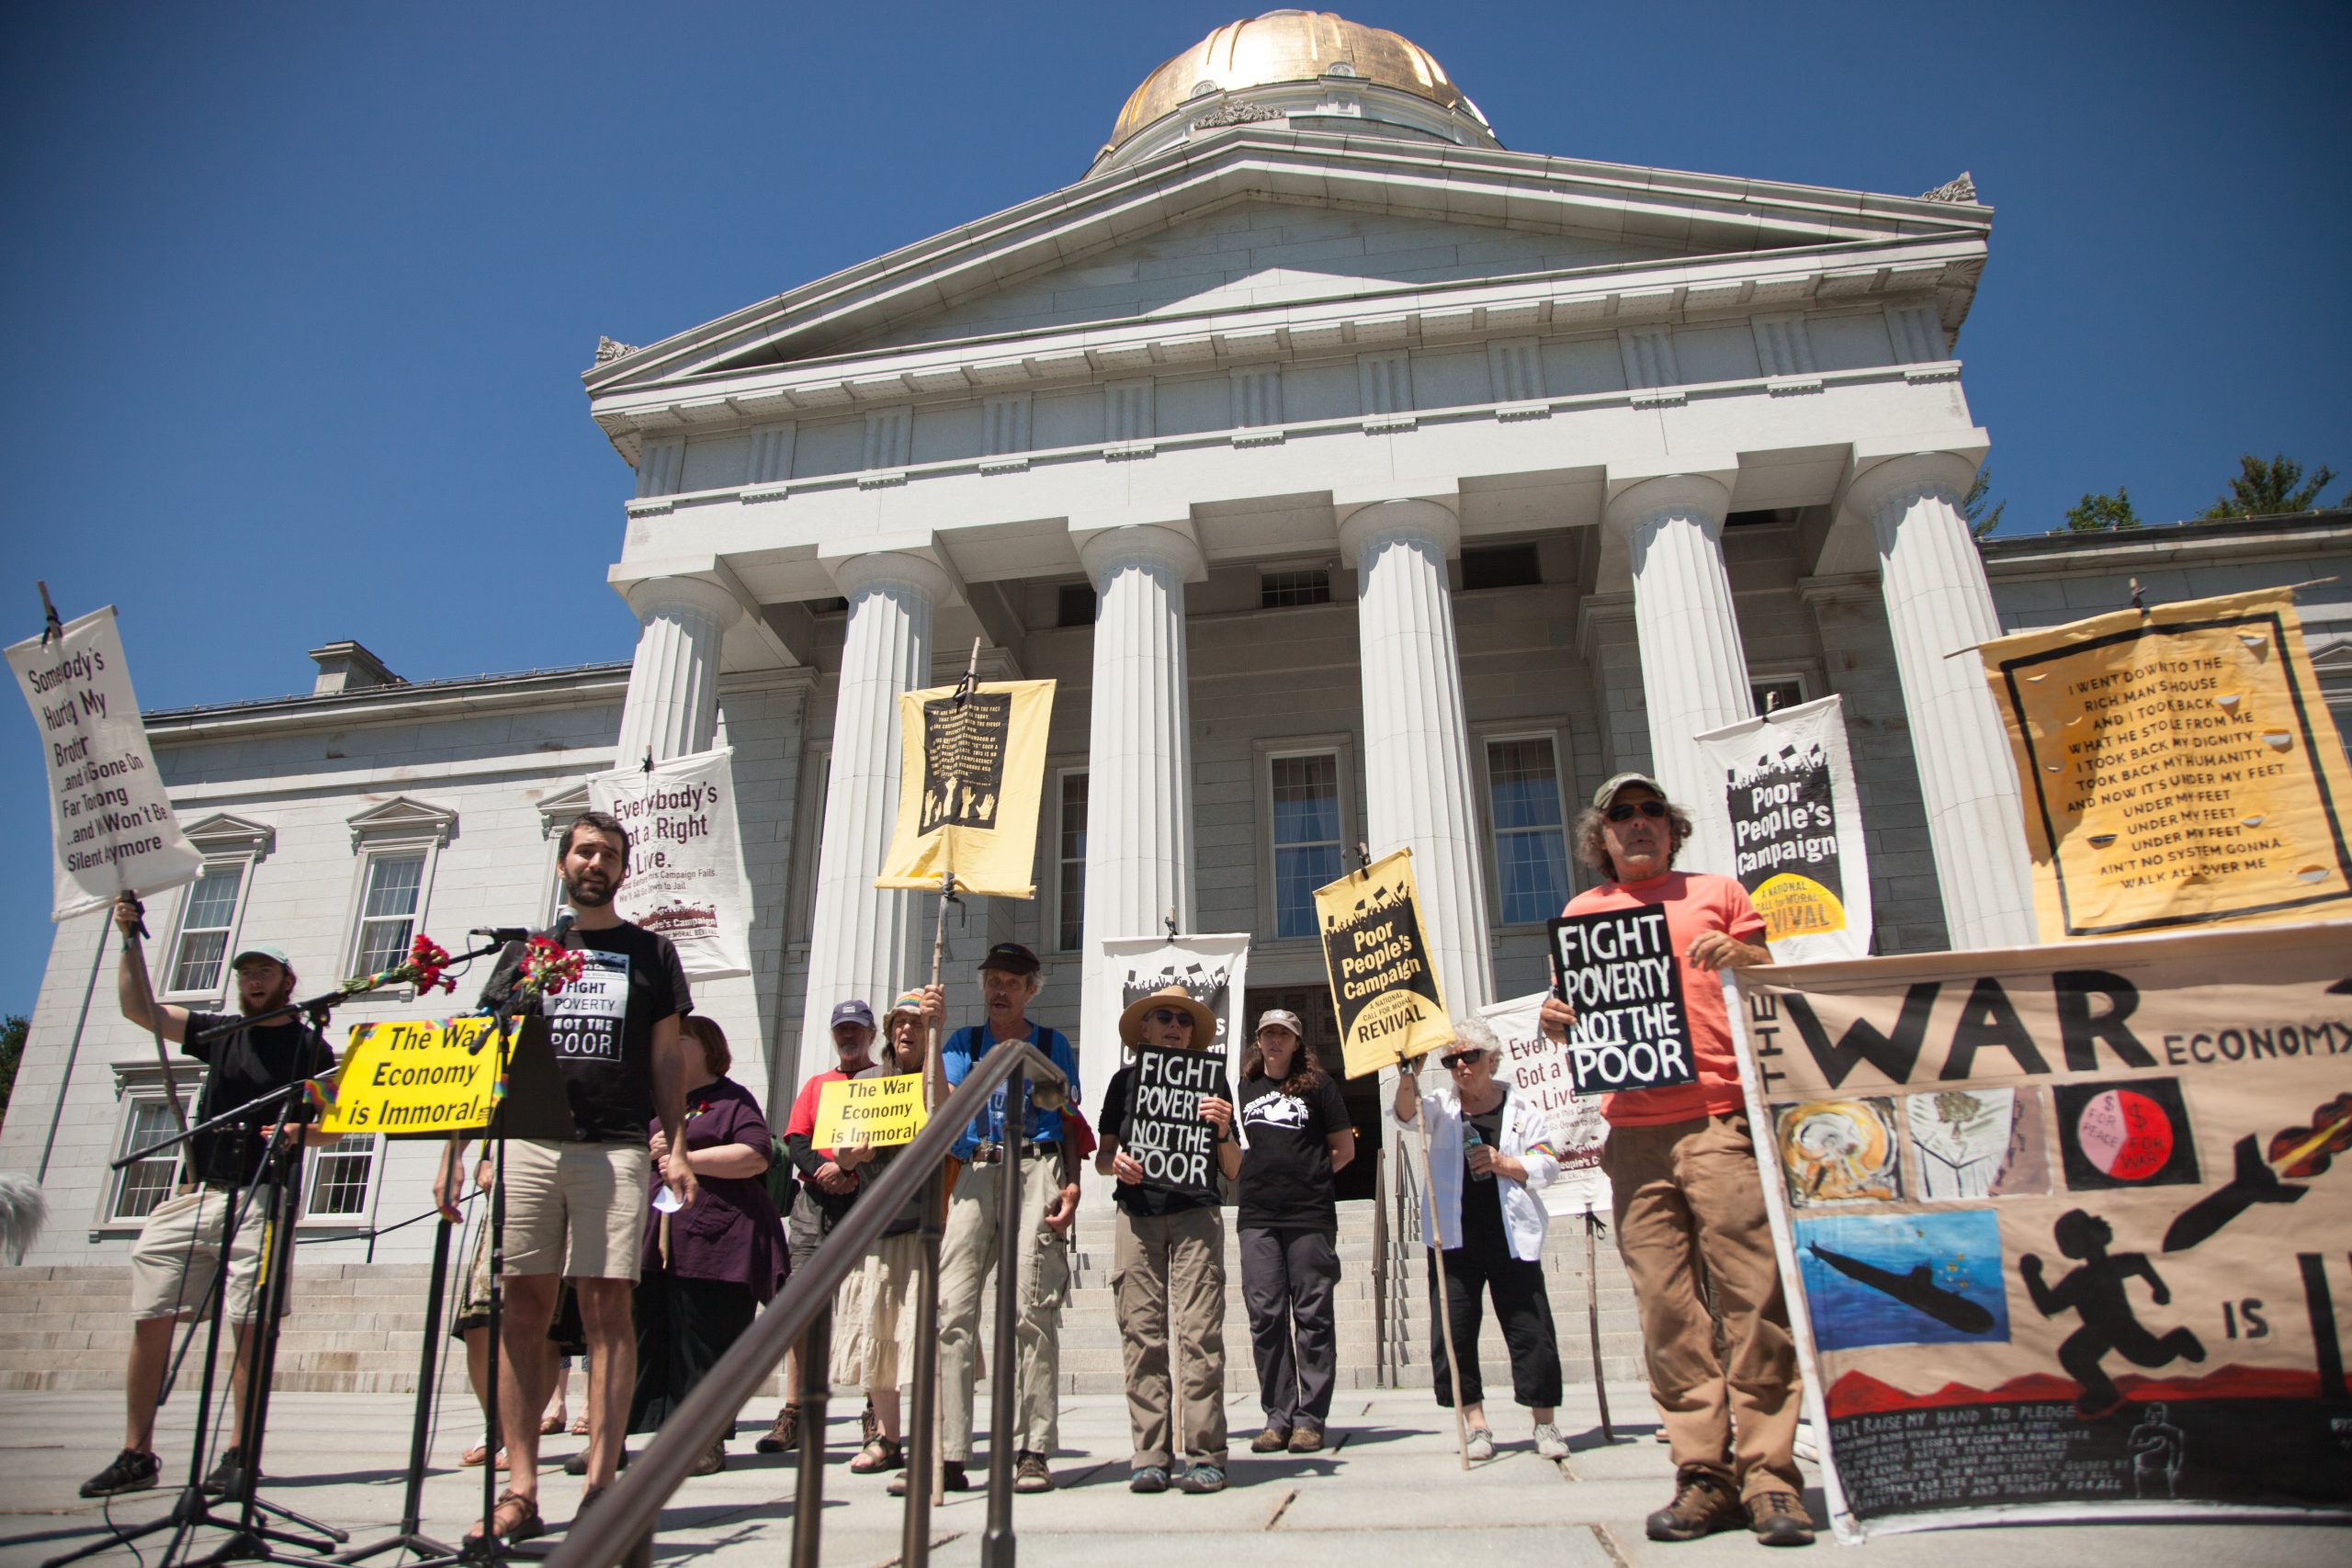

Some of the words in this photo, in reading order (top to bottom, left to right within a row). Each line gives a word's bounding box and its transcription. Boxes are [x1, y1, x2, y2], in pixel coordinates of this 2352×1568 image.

[2067, 684, 2075, 696] I
[2076, 672, 2120, 694] WENT
[2122, 660, 2169, 684] DOWN
[2168, 660, 2188, 674] TO
[2192, 656, 2224, 671] THE
[79, 688, 107, 719] My
[2084, 695, 2120, 713] RICH
[2123, 679, 2168, 705] MAN'S
[2168, 676, 2219, 694] HOUSE
[2093, 714, 2124, 731] AND
[2128, 710, 2134, 723] I
[2137, 699, 2177, 720] TOOK
[2177, 697, 2216, 712] BACK
[2068, 736, 2113, 755] WHAT
[2117, 730, 2138, 745] HE
[2142, 717, 2182, 739] STOLE
[2185, 715, 2227, 730] FROM
[2231, 711, 2255, 726] ME
[86, 759, 128, 781] Gone
[125, 752, 145, 772] On
[2075, 761, 2083, 773] I
[2085, 752, 2127, 773] TOOK
[2130, 739, 2169, 761] BACK
[2172, 736, 2189, 749] MY
[2192, 730, 2255, 749] DIGNITY
[2075, 773, 2119, 792] TOOK
[2121, 762, 2161, 782] BACK
[2164, 755, 2184, 771] MY
[2186, 750, 2264, 768] HUMANITY
[62, 799, 82, 819] Far
[95, 787, 130, 807] ong
[613, 781, 718, 822] Everybody's
[1751, 781, 1802, 815] Poor
[2066, 797, 2097, 813] AND
[2100, 786, 2137, 805] NOW
[2169, 773, 2216, 787] UNDER
[2220, 770, 2242, 784] MY
[2248, 762, 2286, 779] FEET
[102, 806, 153, 833] Won't
[150, 803, 168, 821] Be
[2123, 796, 2174, 818] UNDER
[2176, 790, 2195, 804] MY
[2198, 789, 2232, 802] FEET
[627, 825, 640, 849] ot
[644, 825, 650, 843] a
[656, 814, 708, 845] Right
[1736, 801, 1832, 848] People's
[2127, 814, 2178, 835] UNDER
[2180, 809, 2200, 822] MY
[2203, 807, 2236, 820] FEET
[2132, 830, 2182, 852] UNDER
[2186, 828, 2205, 840] MY
[2208, 825, 2243, 838] FEET
[67, 848, 104, 873] Silent
[637, 851, 672, 876] Live.
[1736, 833, 1838, 876] Campaign
[2100, 859, 2137, 876] AIN'T
[2141, 853, 2165, 868] NO
[2167, 843, 2222, 864] SYSTEM
[2226, 837, 2282, 854] GONNA
[660, 870, 696, 881] Campaign
[2120, 872, 2166, 889] WALK
[2171, 864, 2200, 880] ALL
[2201, 861, 2240, 874] OVER
[2245, 857, 2267, 871] ME
[1761, 887, 1768, 898] A
[1769, 880, 1807, 897] NATIONAL
[1785, 892, 1819, 905] MORAL
[673, 917, 717, 929] Campaign
[1762, 903, 1830, 936] EVIVAL
[1353, 920, 1394, 953] Poor
[1557, 914, 1665, 969] FIGHT
[1341, 934, 1413, 979] People's
[566, 981, 607, 995] FIGHT
[1343, 958, 1422, 1000] Campaign
[1563, 955, 1670, 1008] POVERTY
[554, 998, 616, 1011] POVERTY
[1363, 1010, 1379, 1022] CALL
[1379, 1005, 1391, 1017] FOR
[1391, 996, 1413, 1011] MORAL
[1369, 1002, 1375, 1010] A
[1374, 991, 1404, 1009] NATIONAL
[552, 1018, 582, 1031] NOT
[586, 1018, 614, 1032] THE
[1358, 1003, 1427, 1043] REVIVAL
[1569, 1008, 1625, 1047] NOT
[1625, 1001, 1681, 1042] THE
[1749, 994, 1786, 1094] THE
[1781, 968, 2159, 1090] WAR
[2163, 1021, 2352, 1066] ECONOMY
[390, 1026, 432, 1052] The
[551, 1032, 613, 1055] POOR
[371, 1061, 481, 1089] Economy
[1140, 1051, 1224, 1089] FIGHT
[1516, 1066, 1545, 1090] Got
[1550, 1061, 1561, 1079] a
[1573, 1037, 1690, 1089] POOR
[848, 1082, 876, 1100] The
[883, 1079, 914, 1096] War
[1136, 1085, 1217, 1122] POVERT
[1541, 1086, 1588, 1113] Live.
[348, 1100, 370, 1125] is
[378, 1094, 480, 1125] Immoral
[842, 1102, 913, 1122] Economy
[2088, 1108, 2117, 1124] FOR
[2128, 1101, 2147, 1133] $
[831, 1128, 844, 1144] is
[850, 1121, 917, 1143] Immoral
[1130, 1119, 1171, 1146] NOT
[1171, 1122, 1213, 1154] THE
[2083, 1122, 2119, 1148] PEACE
[2128, 1136, 2164, 1151] FOR
[1130, 1149, 1209, 1188] POOR
[1559, 1158, 1590, 1171] eople's
[2120, 1150, 2158, 1169] WAR
[2222, 1297, 2270, 1340] IS
[1862, 1415, 1904, 1433] RAISE
[1905, 1412, 1928, 1427] MY
[1936, 1409, 1981, 1426] HAND
[1990, 1406, 2012, 1421] TO
[2018, 1404, 2078, 1421] PLEDGE
